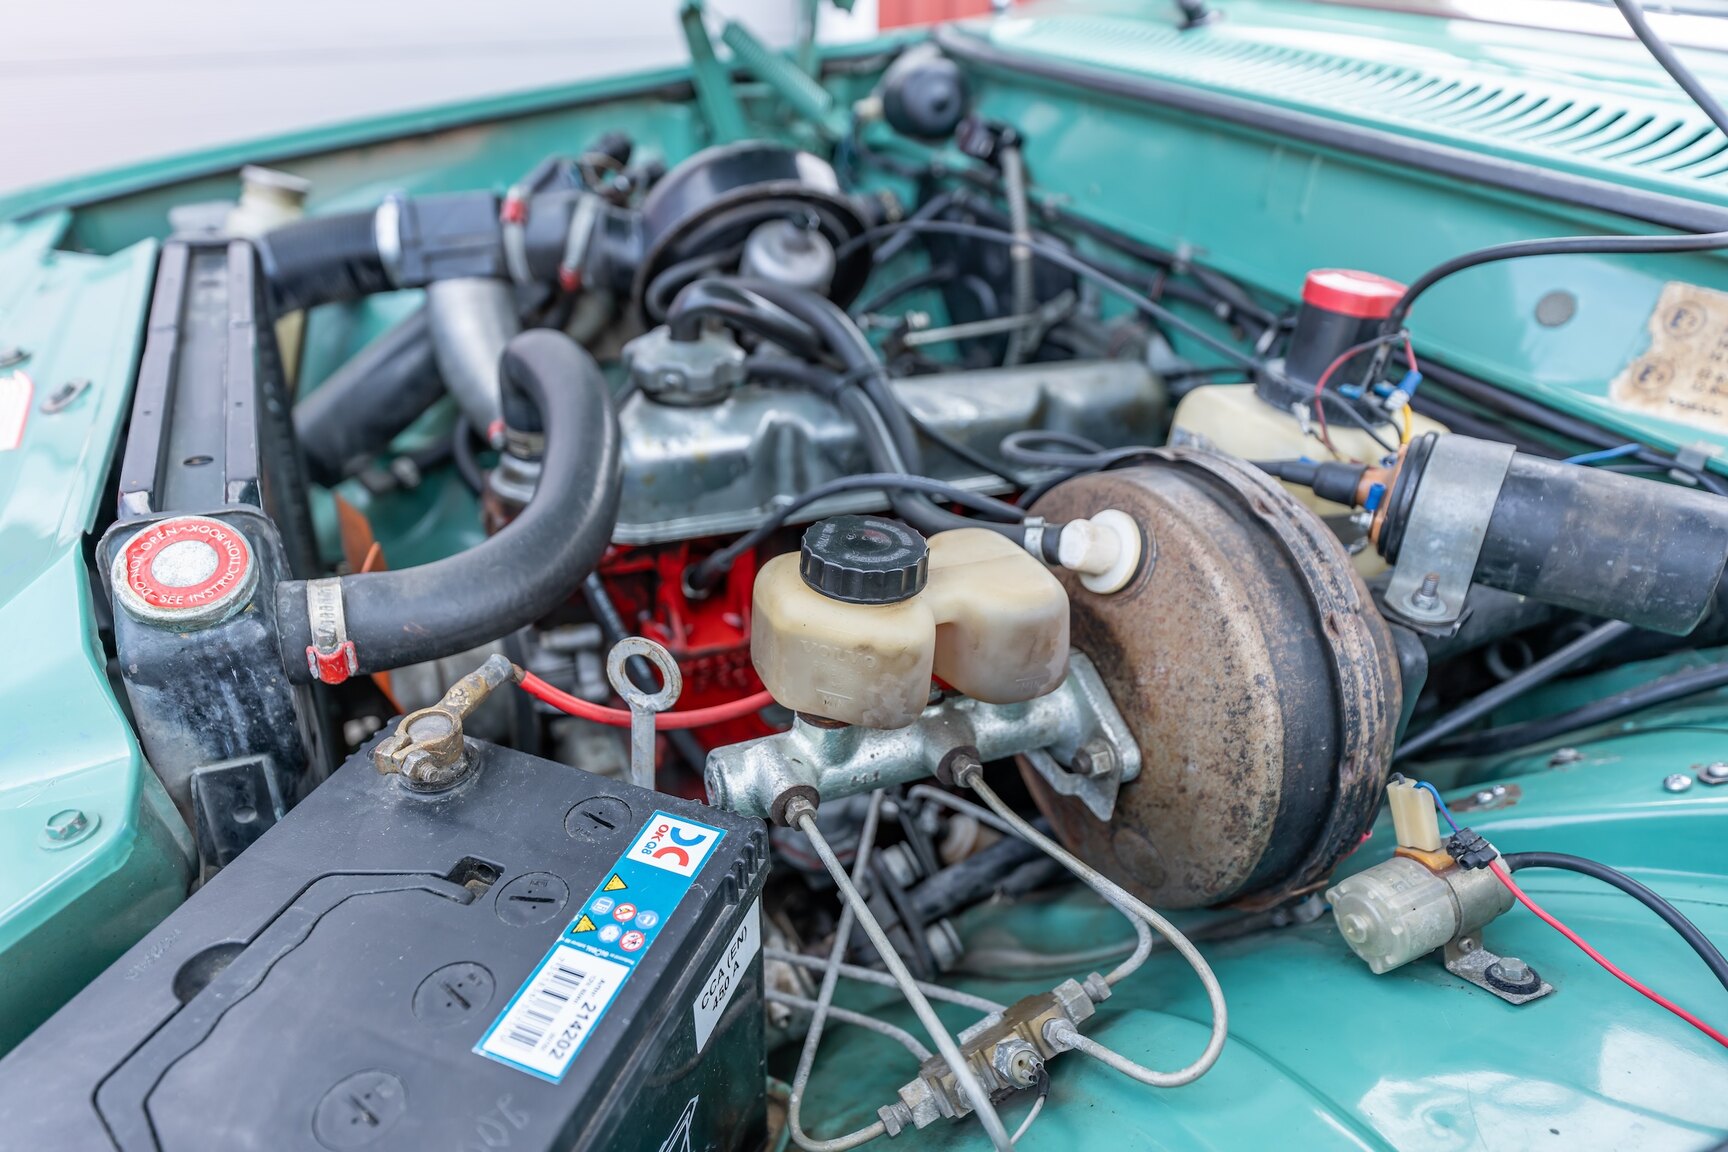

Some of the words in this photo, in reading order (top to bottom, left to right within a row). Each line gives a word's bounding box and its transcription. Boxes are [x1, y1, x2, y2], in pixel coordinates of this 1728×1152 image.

[141, 527, 177, 551] OPEN
[187, 524, 227, 542] BOOK
[130, 554, 145, 578] NOT
[189, 540, 242, 603] INSTRUCTION
[134, 581, 153, 600] DO
[160, 594, 184, 605] SEE
[701, 967, 725, 1010] CCA
[727, 925, 748, 969] (EN)
[712, 975, 730, 1012] 450
[733, 960, 741, 977] A
[548, 1001, 597, 1060] 214202
